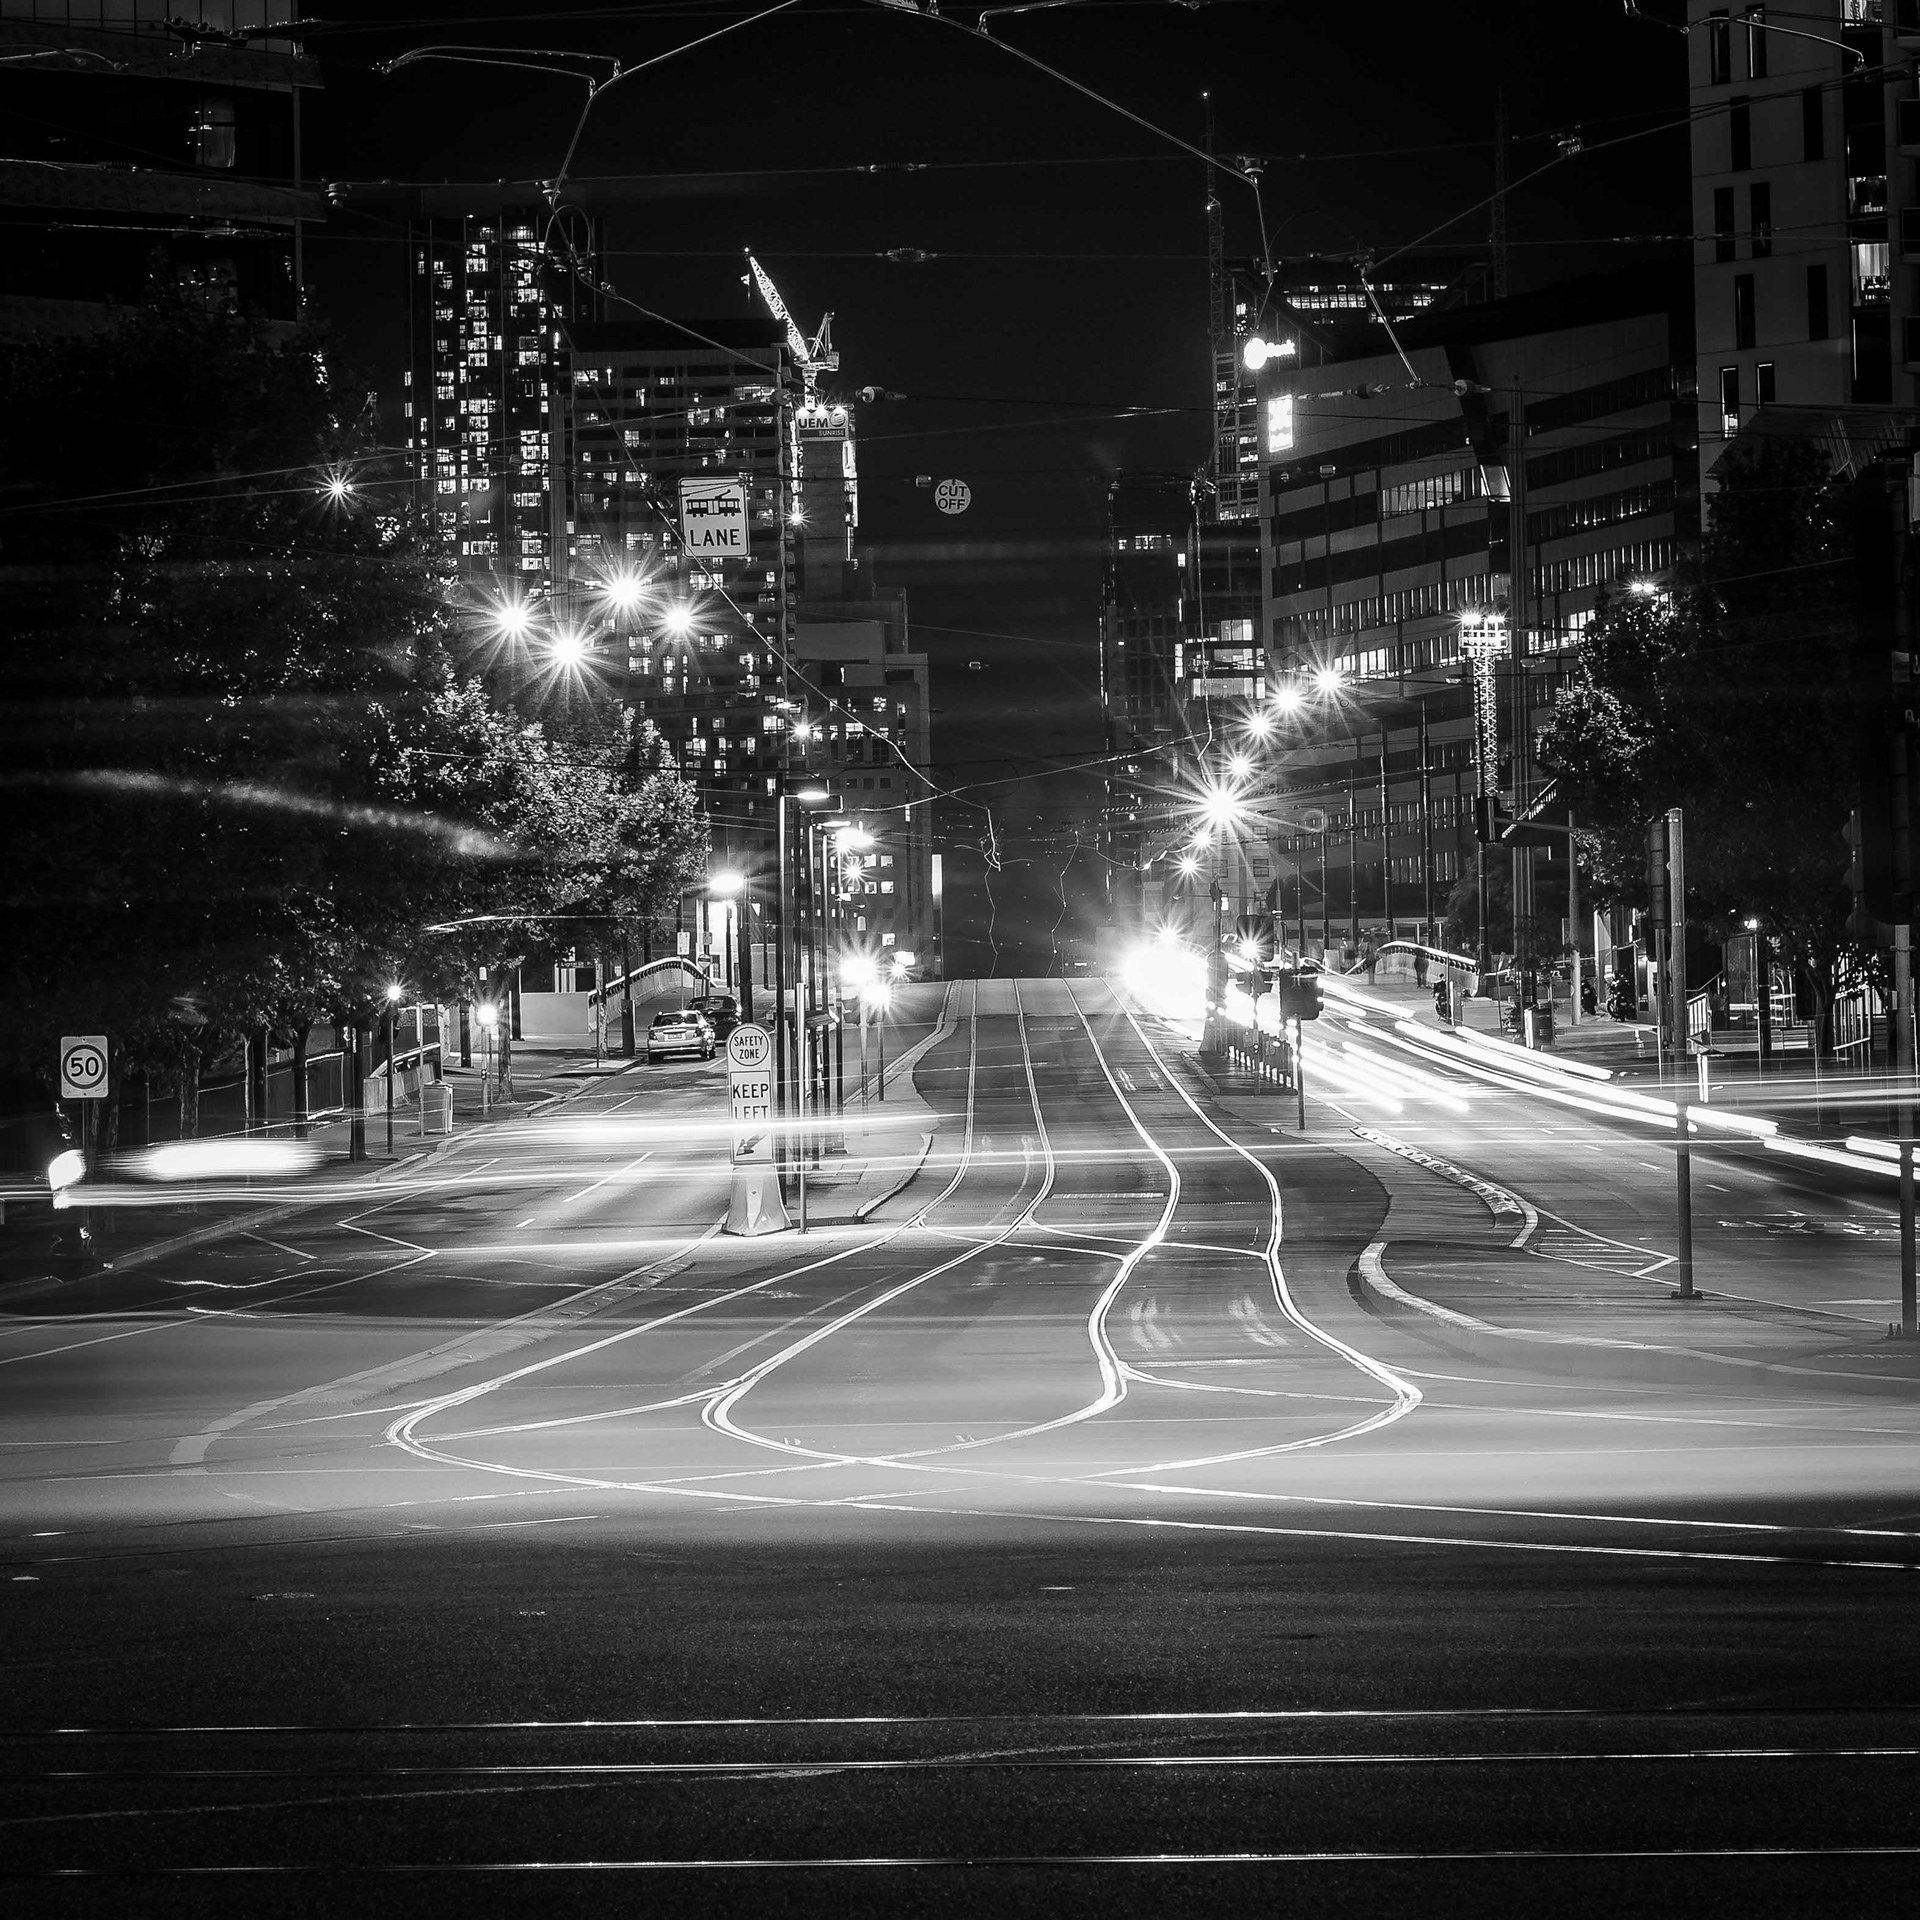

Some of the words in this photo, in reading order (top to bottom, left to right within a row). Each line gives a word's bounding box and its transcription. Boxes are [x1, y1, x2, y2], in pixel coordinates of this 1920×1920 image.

[798, 417, 829, 429] UEM
[938, 484, 968, 497] CUT
[938, 497, 966, 510] OFF
[689, 528, 741, 547] LANE
[733, 1035, 764, 1047] SAFETY
[738, 1048, 760, 1060] ZONE
[70, 1056, 100, 1077] 50
[732, 1083, 769, 1099] KEEP
